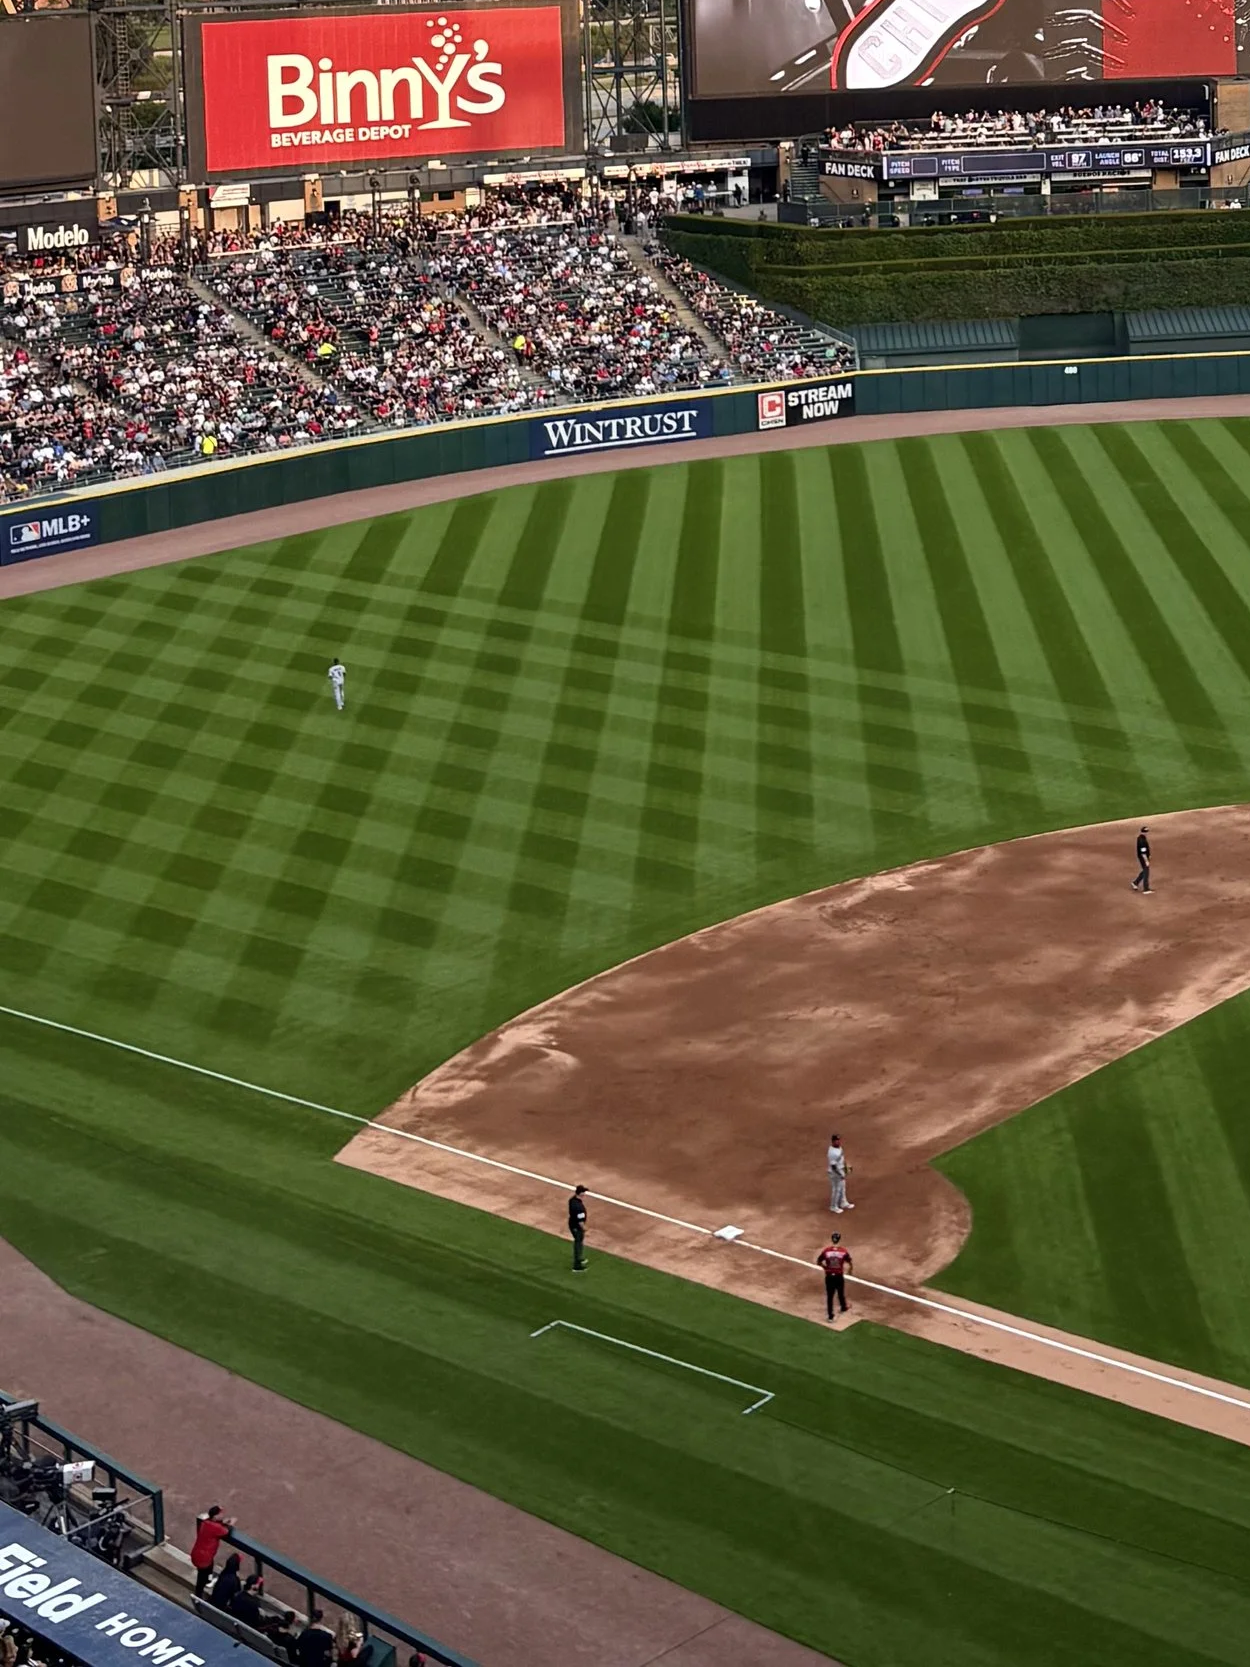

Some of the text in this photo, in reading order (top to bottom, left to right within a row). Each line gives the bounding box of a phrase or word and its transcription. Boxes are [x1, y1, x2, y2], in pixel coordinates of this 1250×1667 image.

[271, 124, 412, 148] BEVERAGE DEPOT
[1215, 145, 1250, 165] FAN DECK
[825, 162, 874, 178] FAN DECK
[27, 223, 89, 251] Modelo
[787, 384, 853, 407] STREAM
[802, 400, 839, 419] NOW
[544, 409, 699, 449] WINTRUST
[0, 1542, 108, 1624] Field
